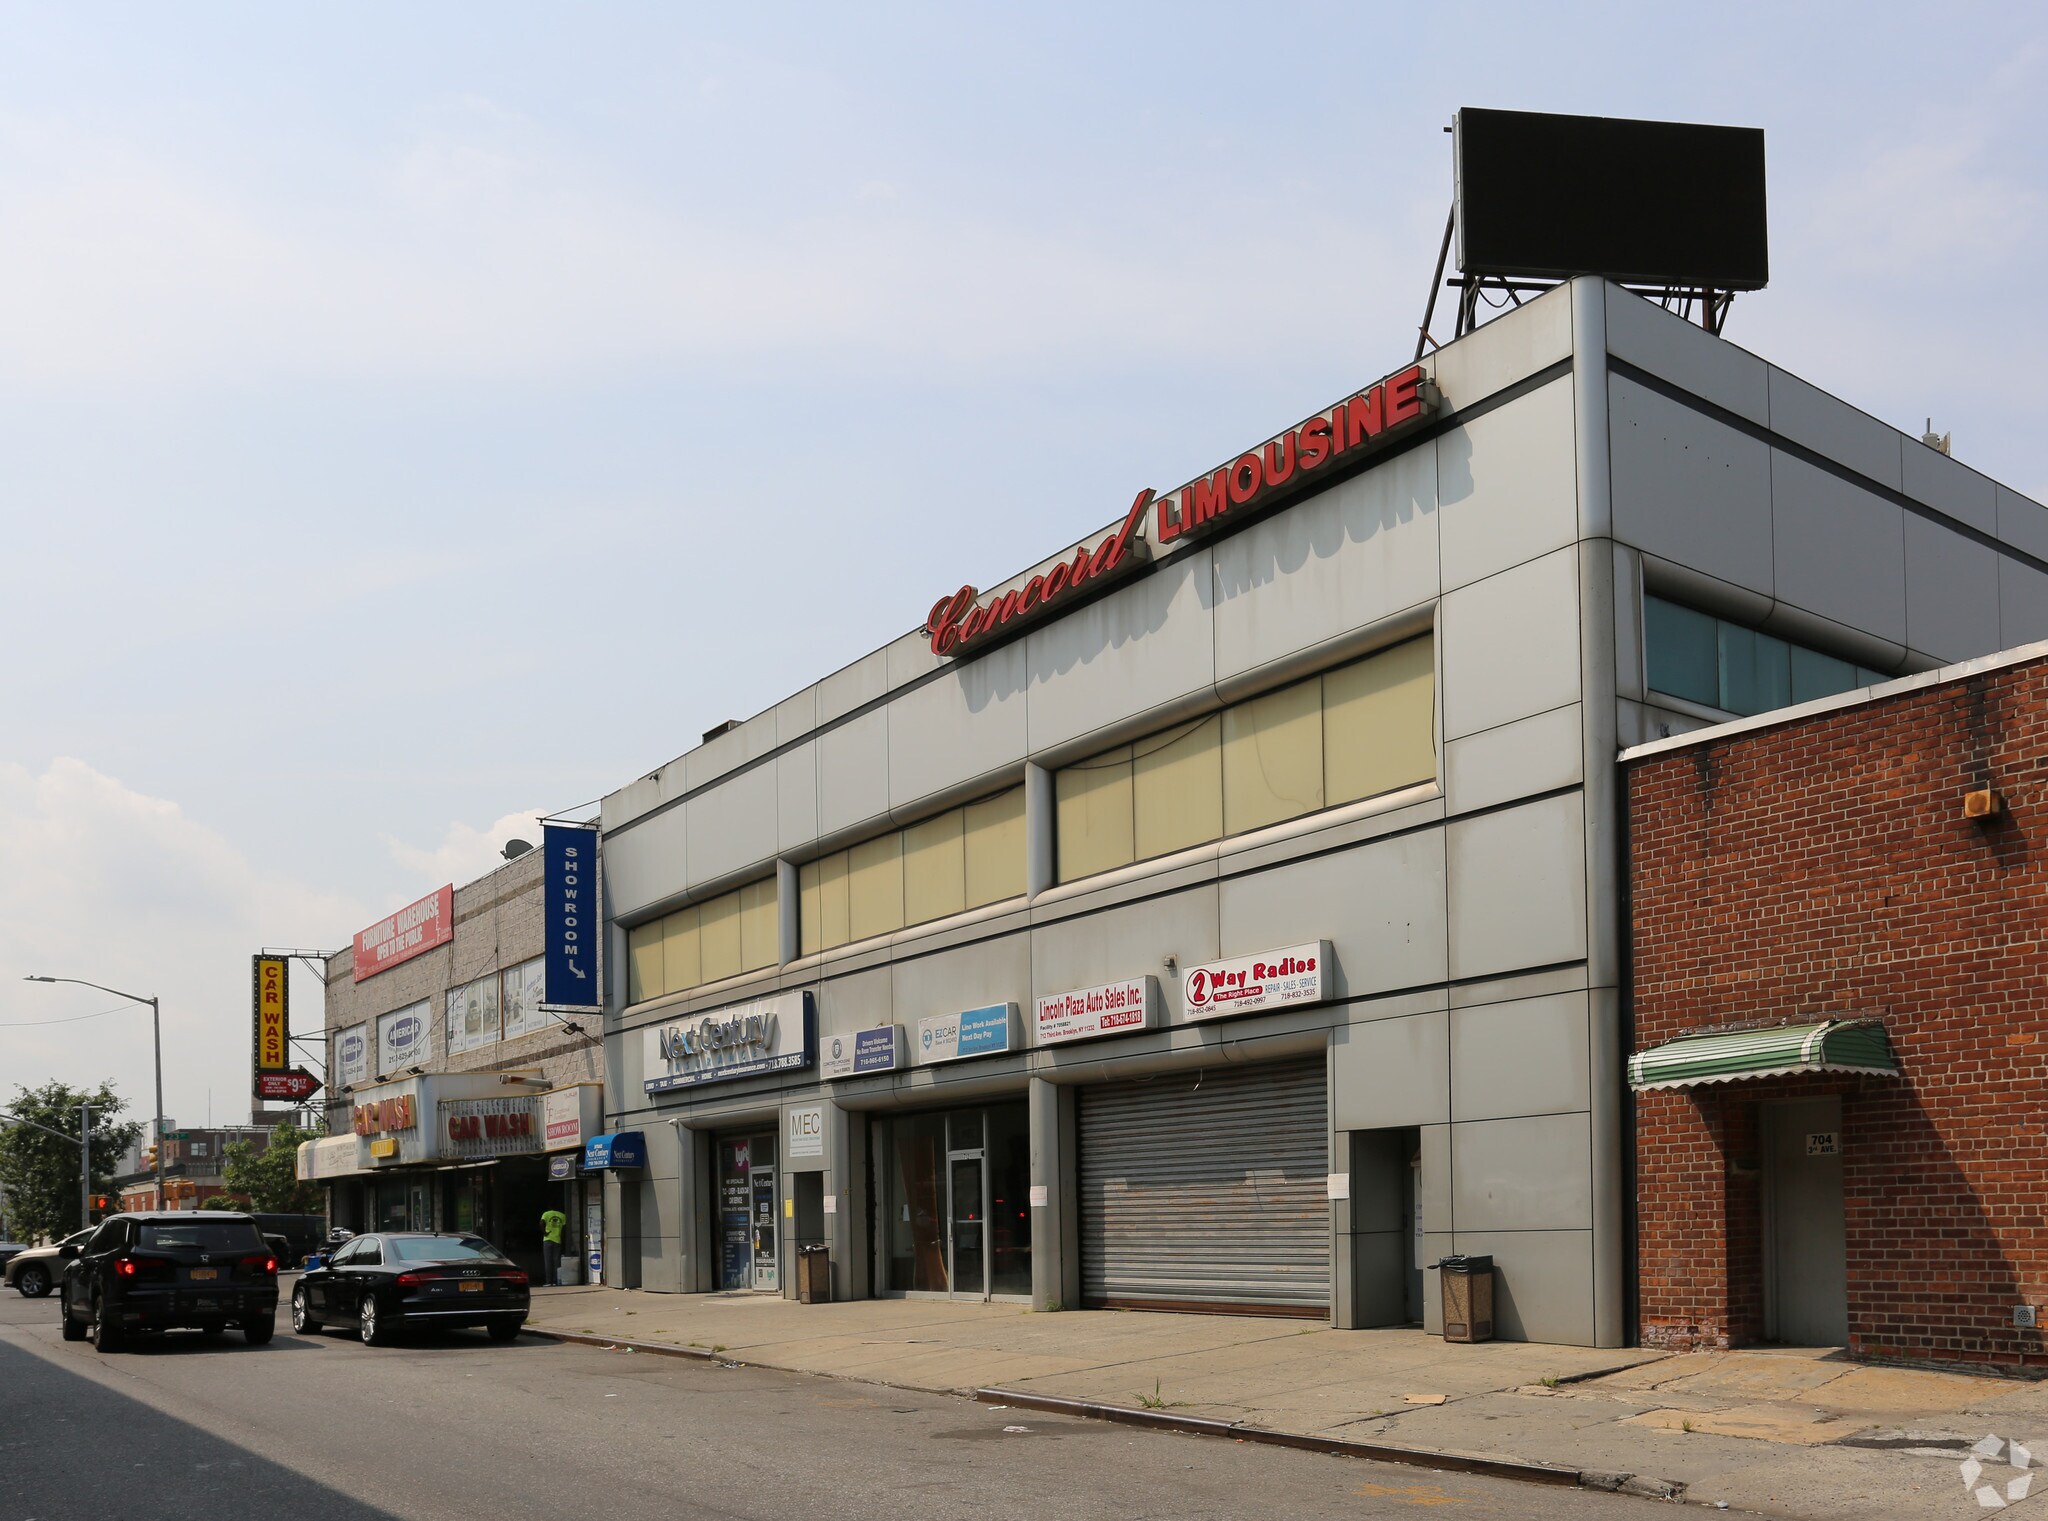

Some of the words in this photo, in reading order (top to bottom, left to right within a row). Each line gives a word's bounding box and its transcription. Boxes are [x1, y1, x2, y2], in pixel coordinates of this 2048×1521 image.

[927, 487, 1157, 657] Concord
[1157, 364, 1424, 544] LIMOUSINE
[565, 847, 578, 955] SHOWROOM
[362, 917, 395, 953] FURNITURE
[396, 893, 439, 935] WAREHOUSE
[376, 942, 390, 962] OPEN
[389, 939, 396, 956] TO
[395, 934, 405, 953] THE
[405, 925, 423, 949] PUBLIC
[264, 966, 279, 1004] CAR
[1192, 972, 1206, 1003] 2
[1210, 970, 1247, 988] Way
[1252, 957, 1317, 981] Radios
[1228, 990, 1244, 999] Right
[1243, 987, 1260, 996] Place
[1264, 983, 1281, 994] REPAIR
[1282, 980, 1297, 991] SALES
[1298, 976, 1317, 988] SERVICE
[1280, 988, 1316, 1000] 718-832-3535
[1039, 998, 1064, 1021] Lincoln
[1065, 995, 1084, 1017] Plaza
[1086, 991, 1104, 1013] Auto
[1104, 986, 1125, 1010] Sales
[1127, 984, 1142, 1006] Inc.
[1233, 996, 1266, 1008] 718-492-0997
[264, 1012, 280, 1063] WASH
[660, 1023, 698, 1060] Next
[699, 1013, 772, 1051] Century
[983, 1030, 993, 1039] Pay
[448, 1114, 481, 1141] CAR
[484, 1112, 531, 1138] WASH
[547, 1121, 578, 1137] SHOWROOM
[792, 1113, 820, 1136] MEC
[586, 1149, 596, 1158] Next
[595, 1148, 609, 1159] Century
[1811, 1134, 1833, 1145] 704
